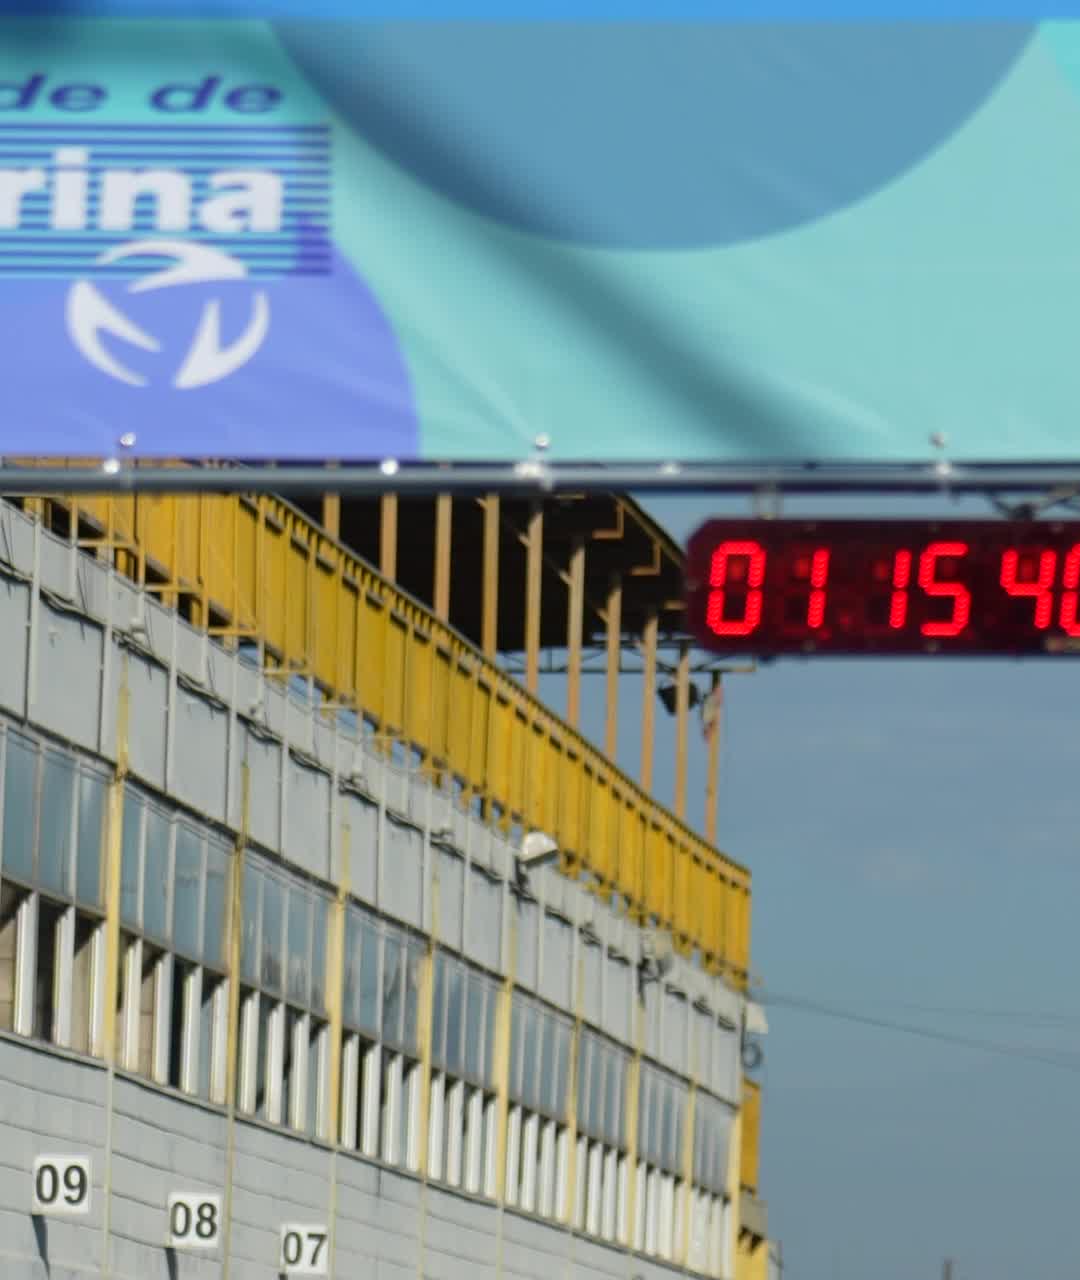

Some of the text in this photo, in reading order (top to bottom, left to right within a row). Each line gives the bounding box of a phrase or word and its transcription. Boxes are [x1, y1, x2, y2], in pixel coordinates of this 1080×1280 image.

[149, 74, 283, 114] de
[35, 1164, 88, 1206] 09
[169, 1202, 218, 1239] 08
[282, 1232, 327, 1266] 07
